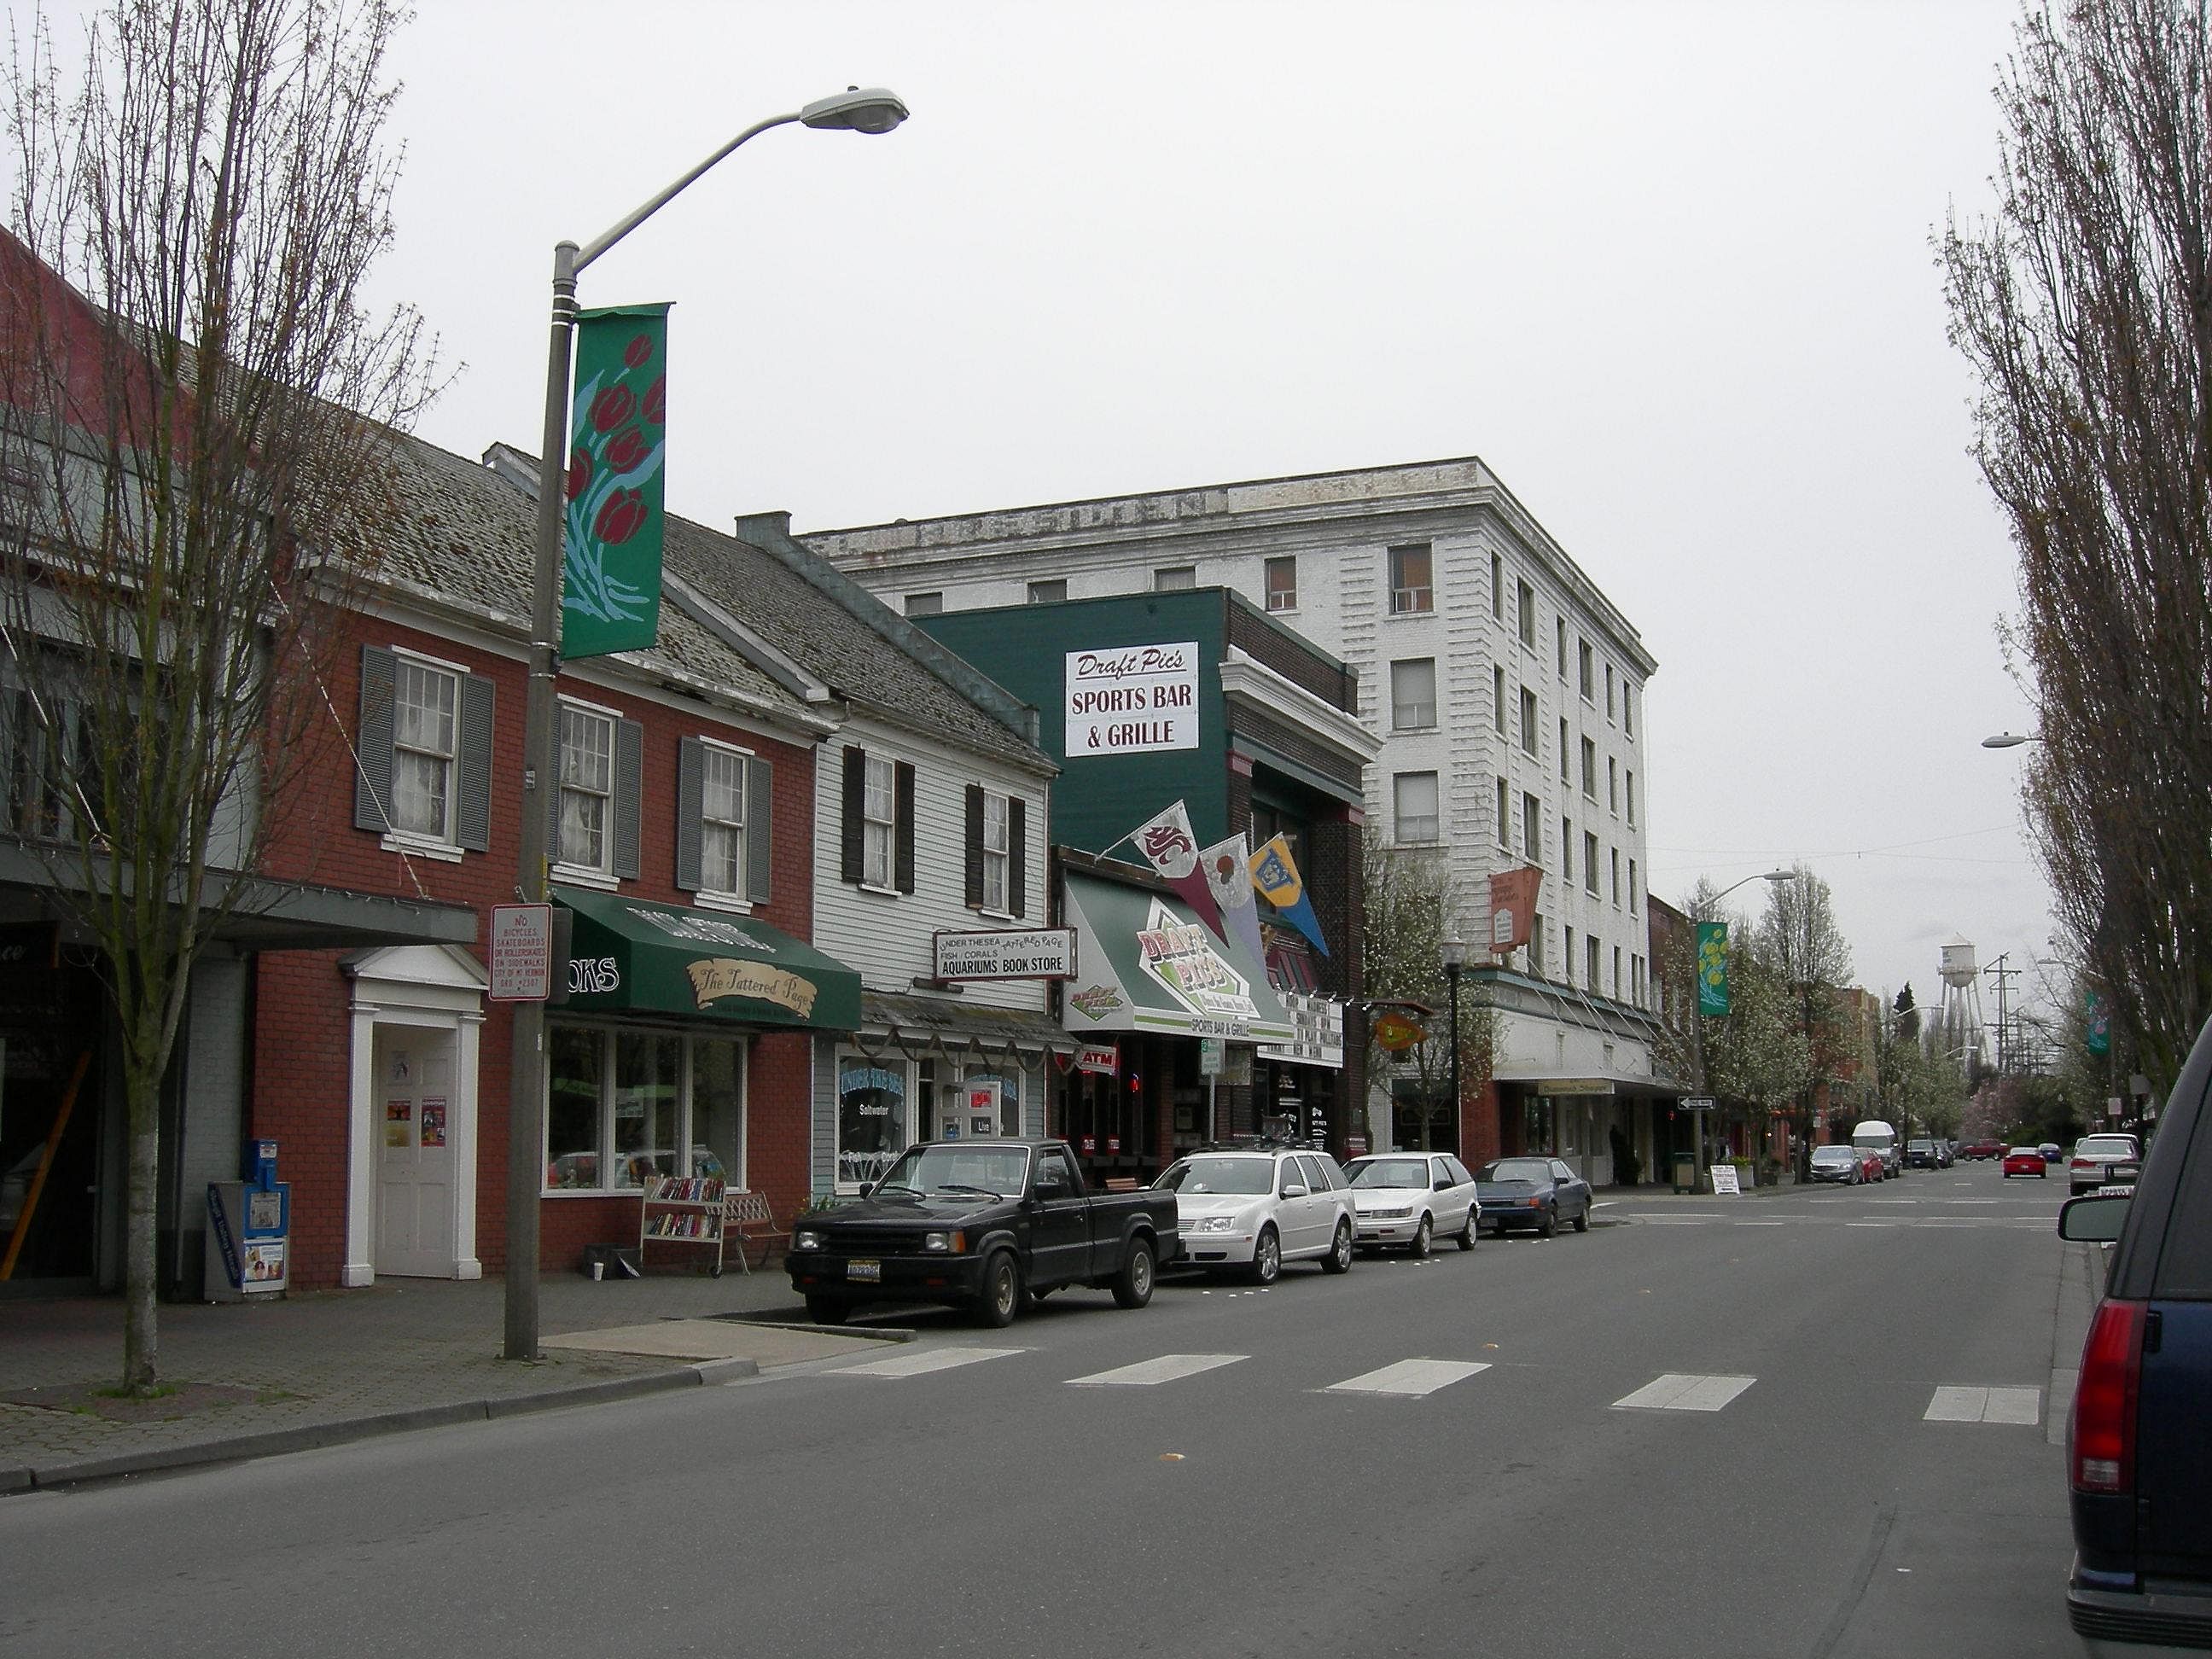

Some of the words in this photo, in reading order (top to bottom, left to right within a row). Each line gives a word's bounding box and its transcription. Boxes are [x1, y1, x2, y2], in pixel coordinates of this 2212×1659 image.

[1078, 654, 1138, 680] Draft
[1141, 649, 1185, 672] Pic's
[1072, 688, 1146, 715] SPORTS
[1154, 684, 1191, 708] BAR
[1088, 725, 1101, 748] &
[1108, 720, 1174, 747] GRILLE
[515, 915, 528, 927] NO
[504, 928, 538, 937] BICYCLES
[940, 938, 967, 952] UNDER
[984, 938, 1000, 946] SEA
[1003, 937, 1040, 951] TATTERED
[1042, 936, 1063, 948] PAGE
[964, 950, 998, 958] CORALS
[942, 959, 998, 976] AQUARIUMS
[1003, 958, 1029, 973] BOOK
[1031, 957, 1062, 971] STORE
[701, 969, 723, 991] The
[726, 969, 779, 994] Tattered
[783, 976, 808, 1010] Page
[1191, 1018, 1213, 1033] SPORTS
[1214, 1022, 1225, 1034] BAR
[1231, 1023, 1249, 1037] GRILLE
[1082, 1051, 1113, 1066] ATM
